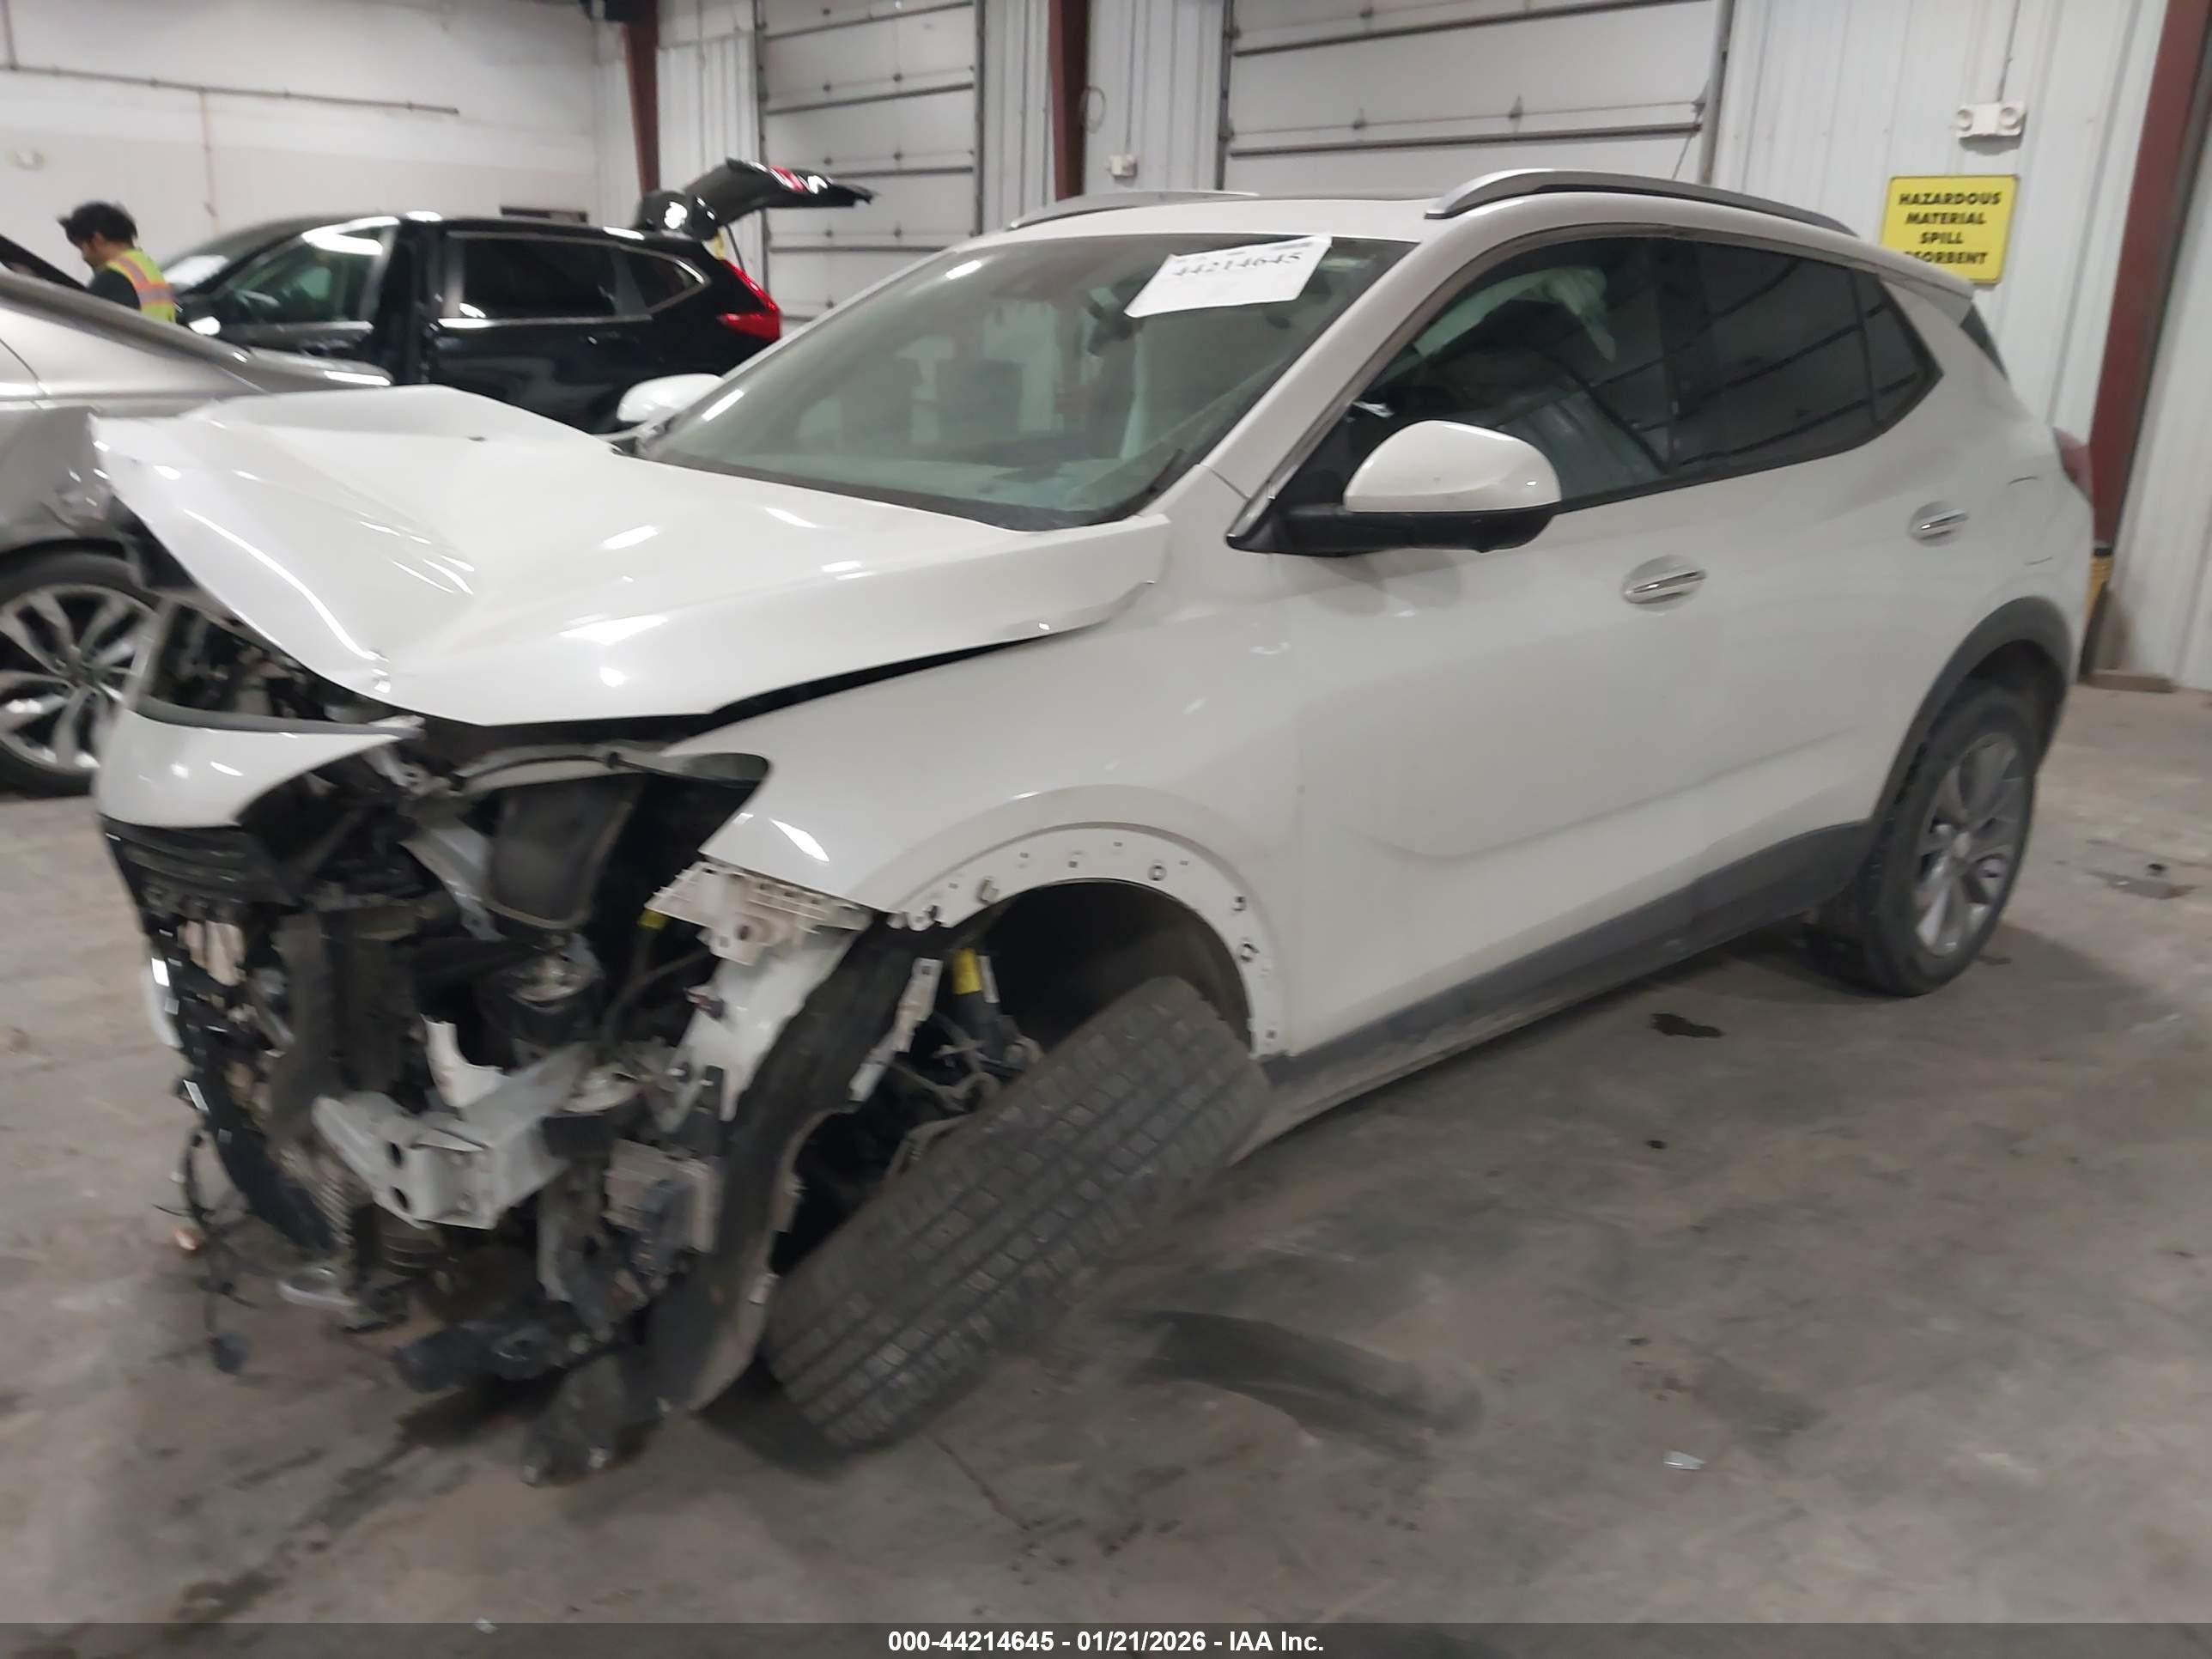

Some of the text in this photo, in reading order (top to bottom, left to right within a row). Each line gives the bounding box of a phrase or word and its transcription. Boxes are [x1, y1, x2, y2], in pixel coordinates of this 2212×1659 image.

[1899, 192, 2002, 204] HAZARDOUS
[1905, 213, 1986, 225] MATERIAL
[1919, 232, 1963, 244] SPILL
